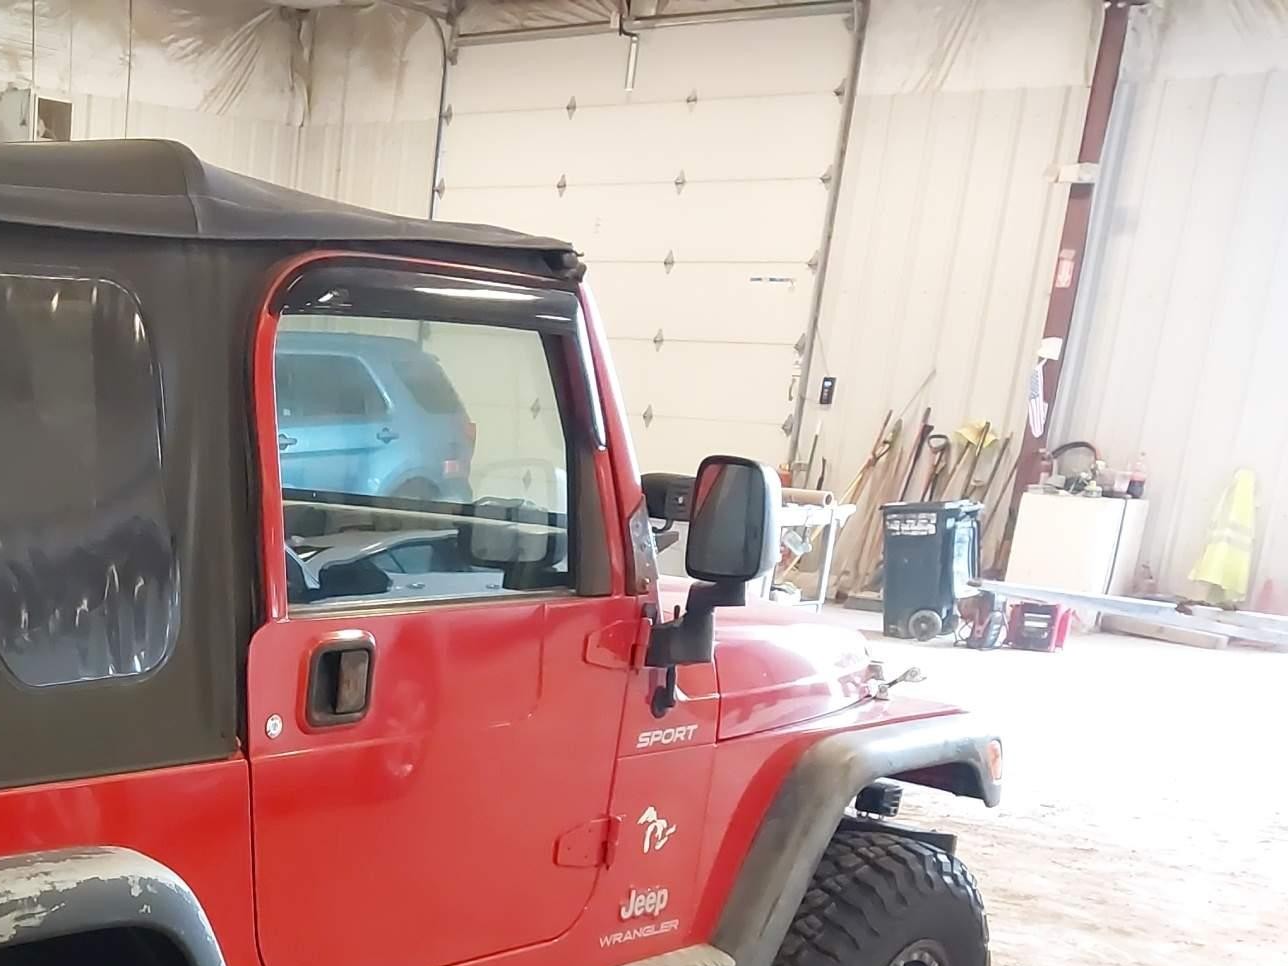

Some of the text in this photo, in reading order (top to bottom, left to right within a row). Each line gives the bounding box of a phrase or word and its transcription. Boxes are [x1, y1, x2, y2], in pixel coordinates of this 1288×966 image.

[636, 724, 698, 749] SPORT
[620, 887, 669, 920] Jeep
[599, 919, 680, 948] WRANGLER
